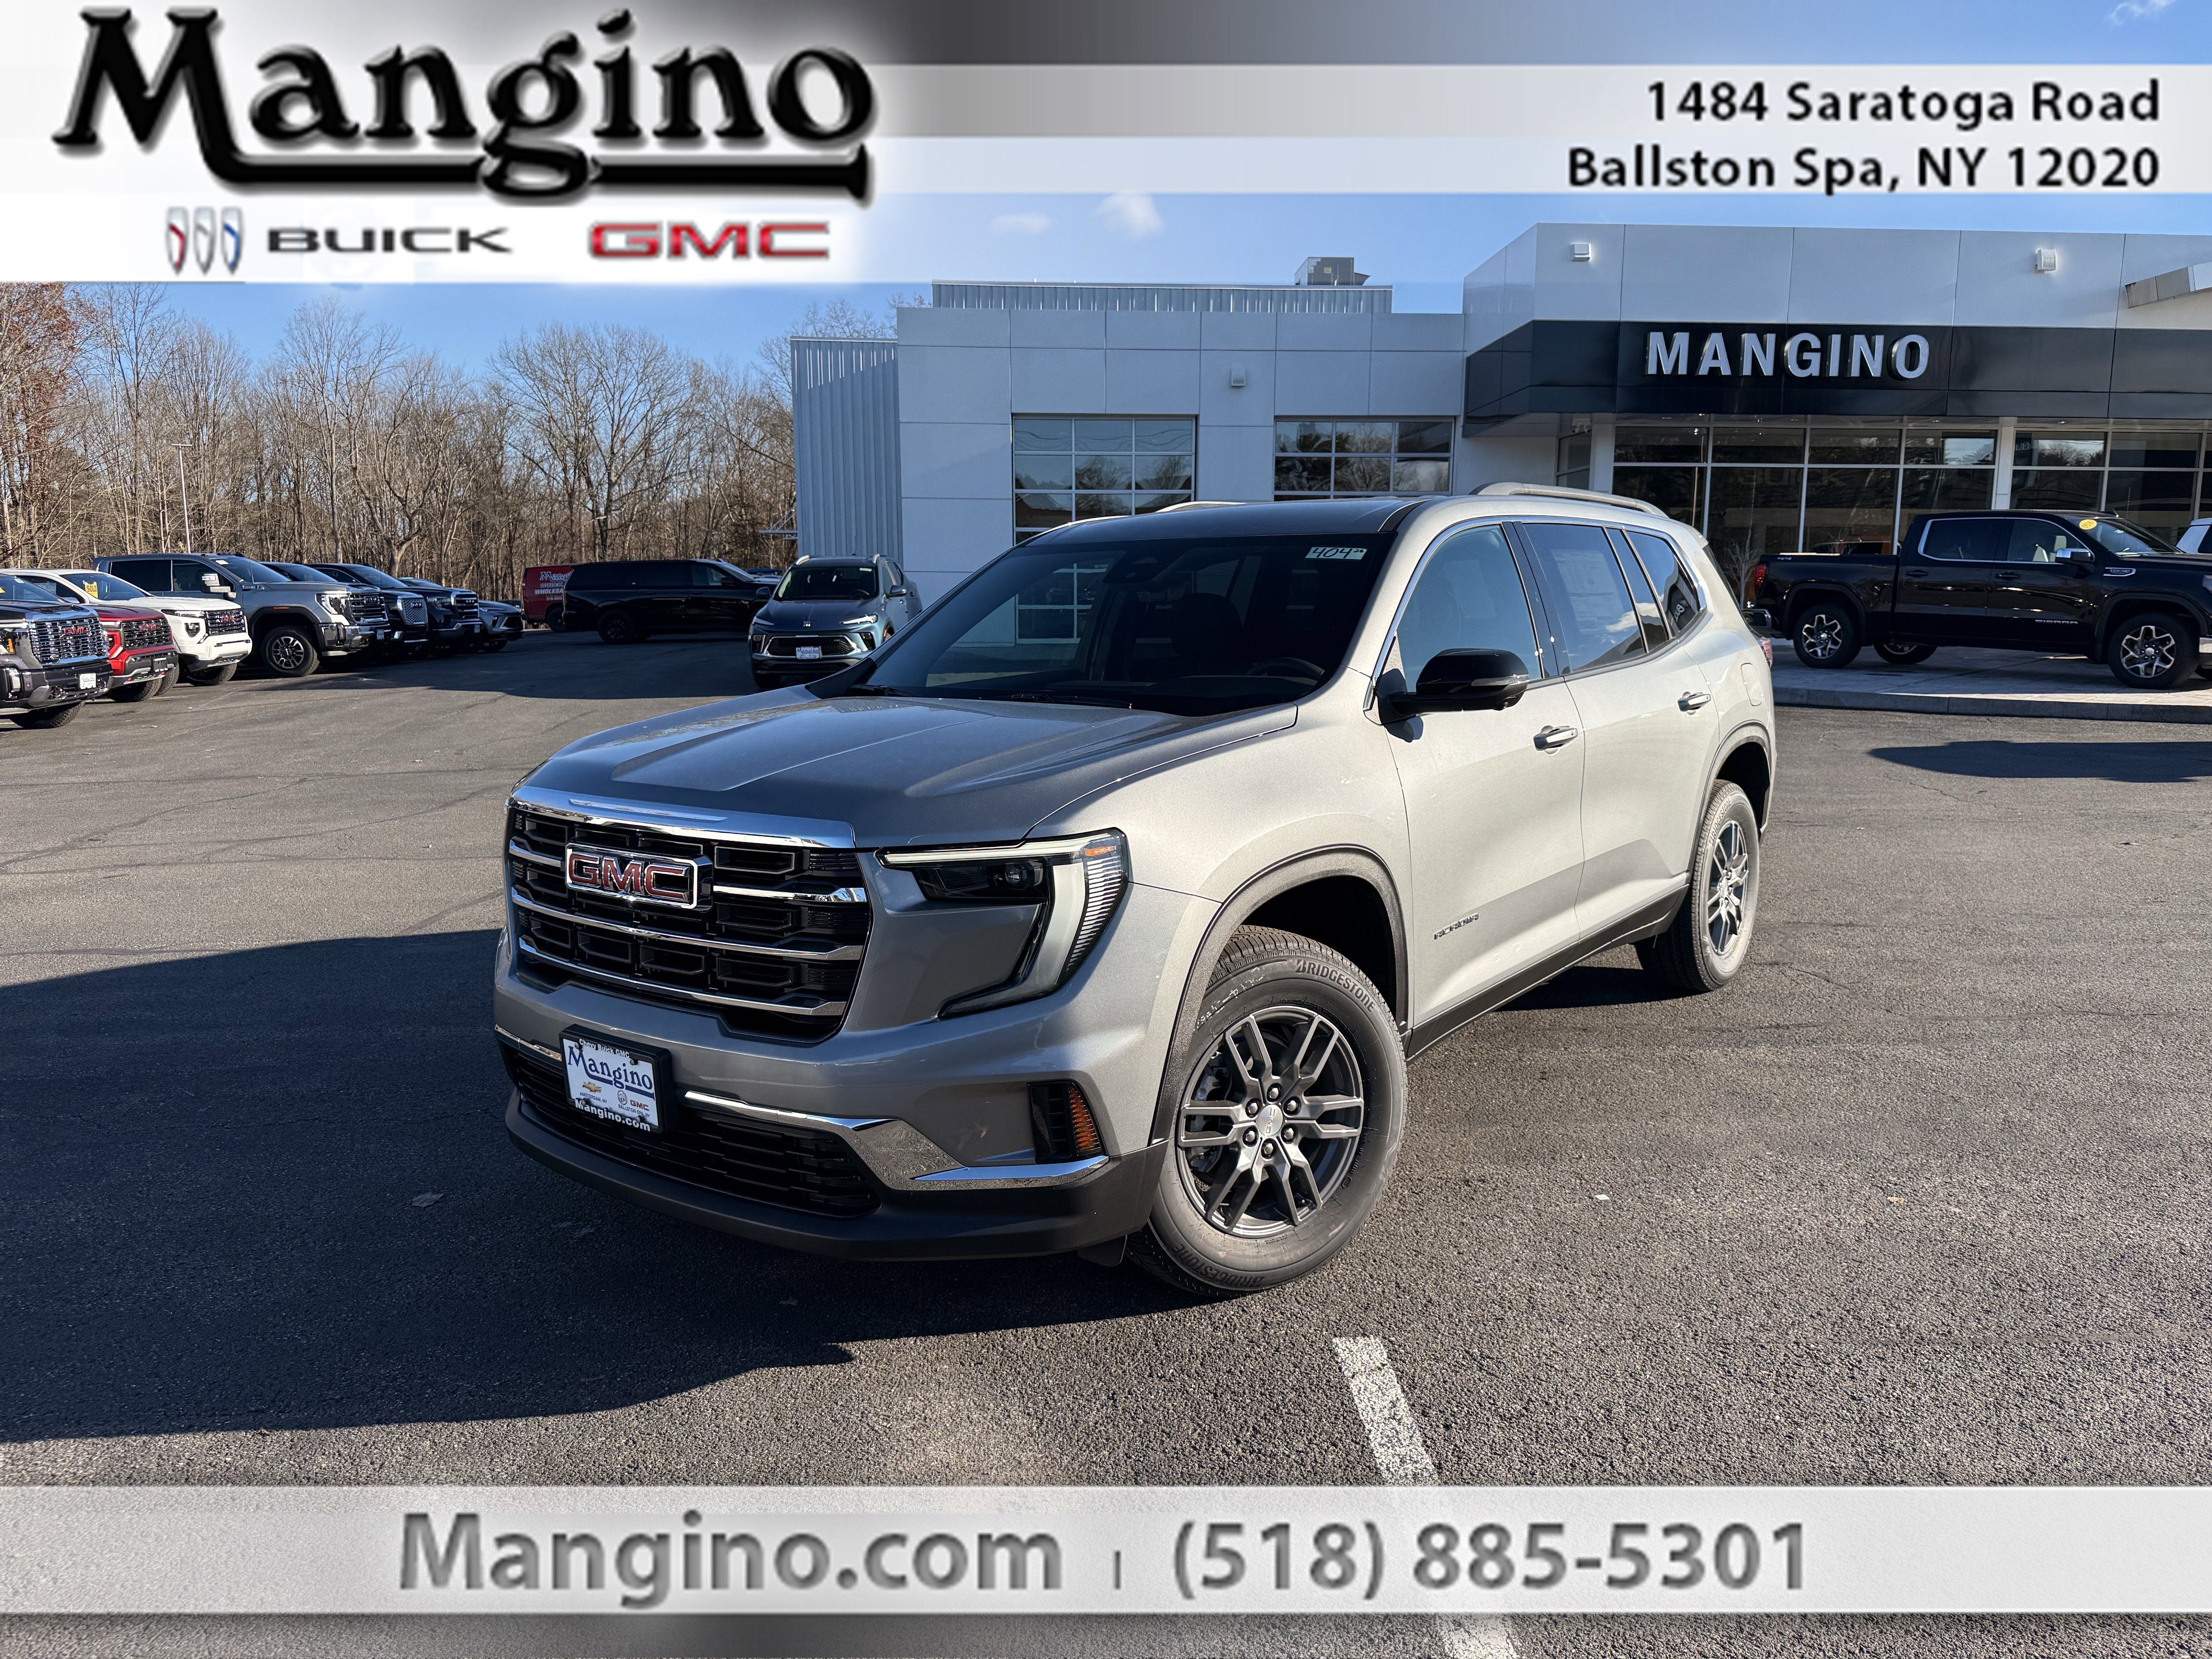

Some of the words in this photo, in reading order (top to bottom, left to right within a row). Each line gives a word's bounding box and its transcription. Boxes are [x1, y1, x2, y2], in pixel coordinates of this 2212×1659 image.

[1645, 331, 1930, 380] MANGINO
[1312, 548, 1353, 558] 404
[568, 851, 690, 903] GMC
[1295, 958, 1376, 1012] BRIDGESTONE
[579, 1038, 596, 1051] Chevy
[597, 1044, 615, 1054] Buick
[615, 1049, 630, 1059] GMC
[568, 1046, 655, 1101] Mangino
[575, 1099, 651, 1132] Mangino.com
[630, 1099, 650, 1111] GMC
